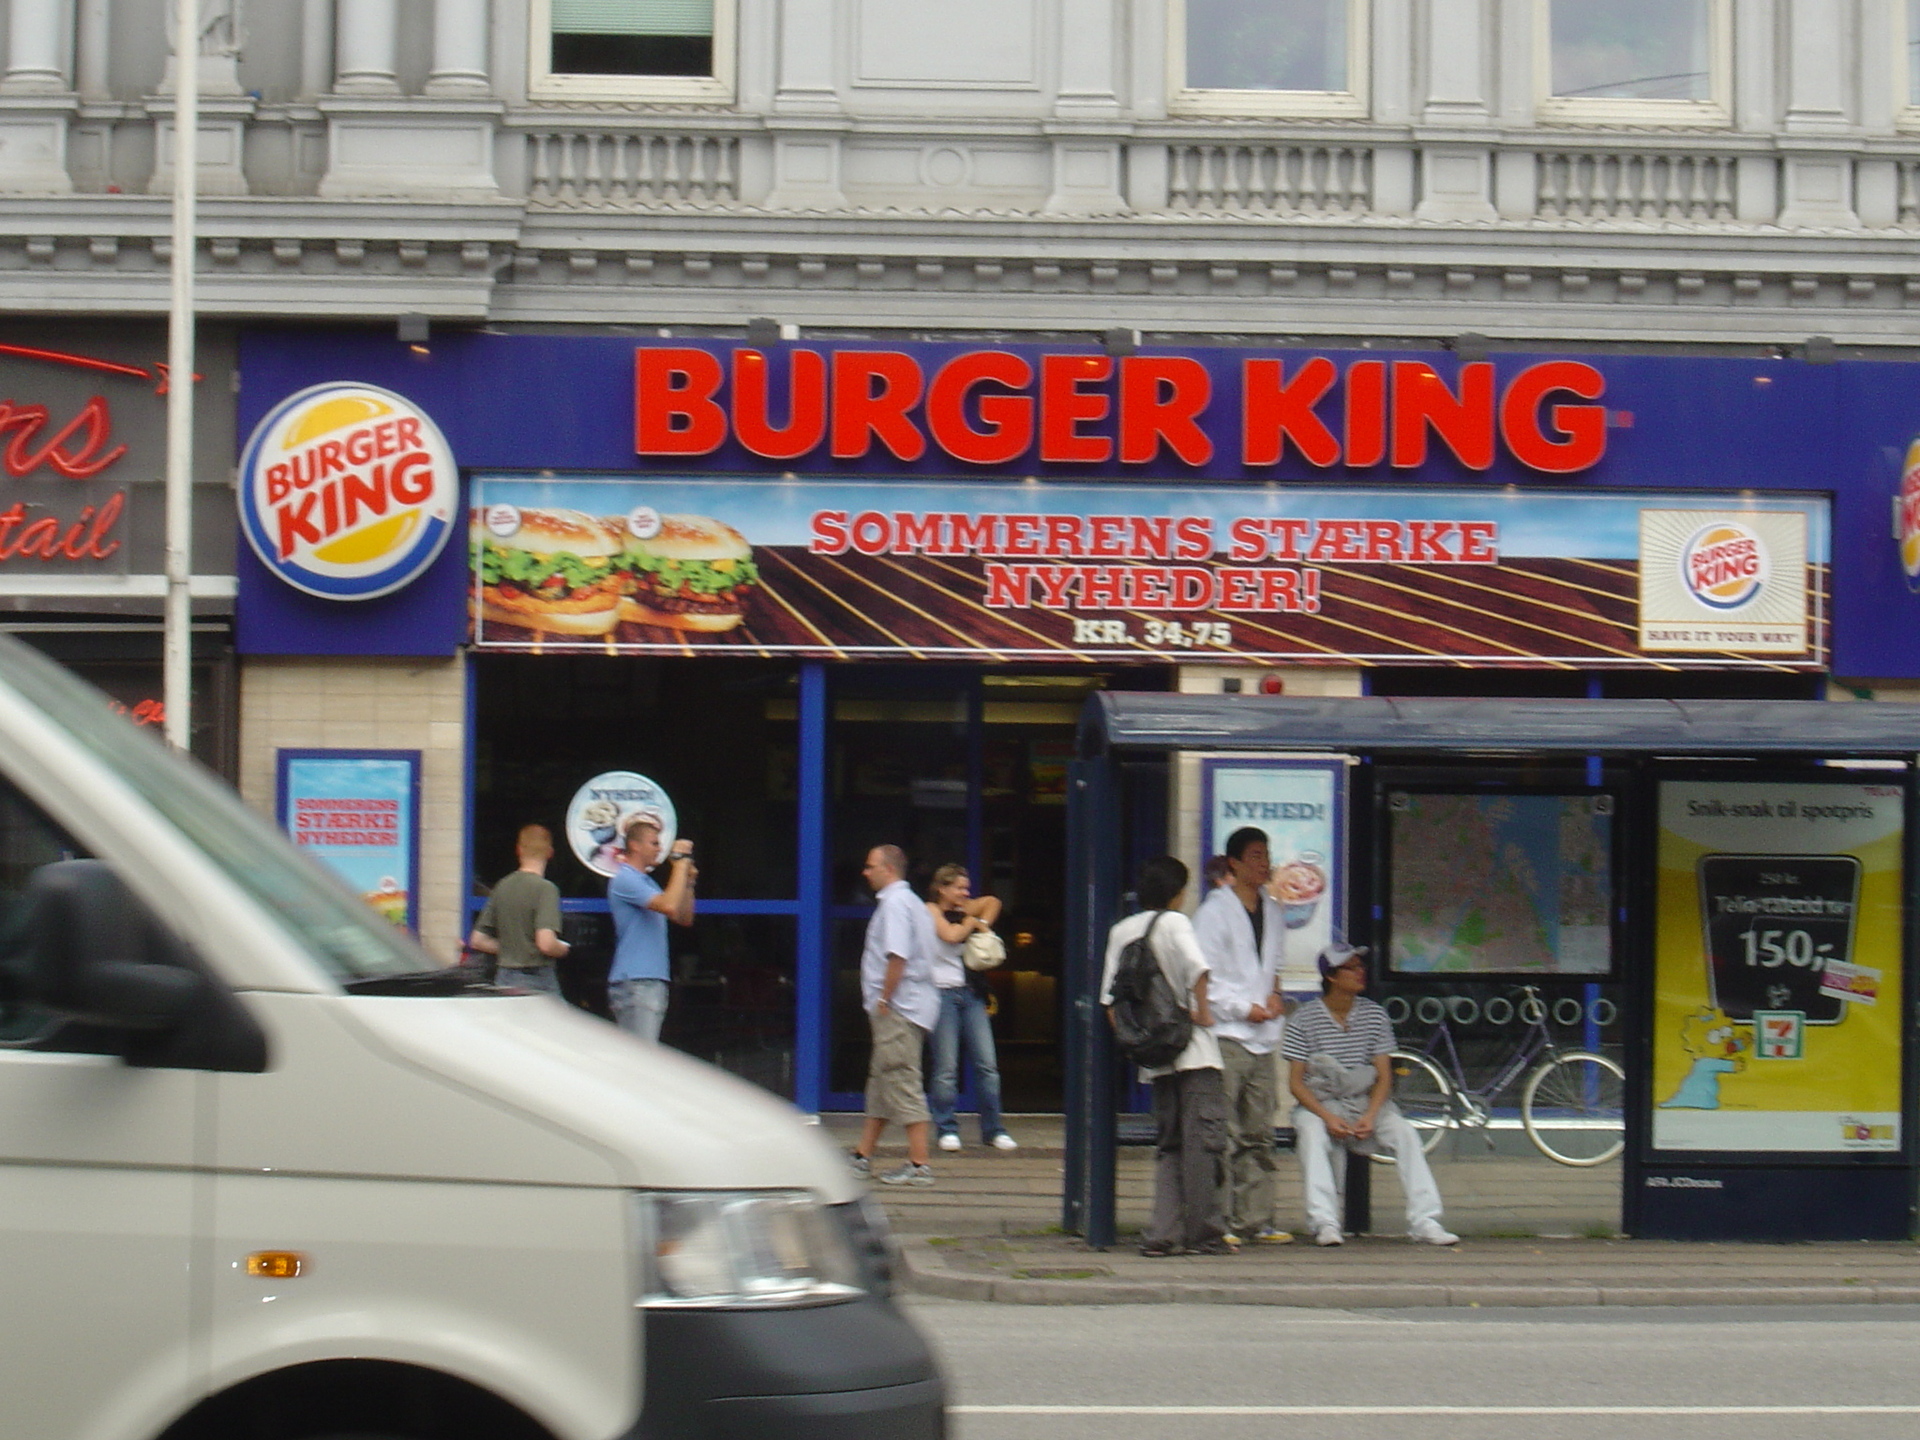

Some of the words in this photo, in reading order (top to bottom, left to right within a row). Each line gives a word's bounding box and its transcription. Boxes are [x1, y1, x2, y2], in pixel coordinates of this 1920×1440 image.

[634, 346, 1214, 467] BURGER
[1241, 356, 1607, 474] KING
[265, 416, 424, 505] BURGER
[277, 452, 434, 562] KING
[810, 509, 1215, 561] SOMMERENS
[1229, 516, 1499, 565] STÆRKE
[1691, 539, 1757, 569] BURGER
[983, 563, 1321, 614] NYHEDER!
[1693, 554, 1760, 591] KING
[1073, 619, 1137, 645] KR.
[1143, 621, 1232, 648] 34,75
[1648, 630, 1692, 642] HAVE
[1694, 631, 1713, 642] IT
[1715, 631, 1757, 643] YOUR
[1222, 801, 1325, 821] NYHED!
